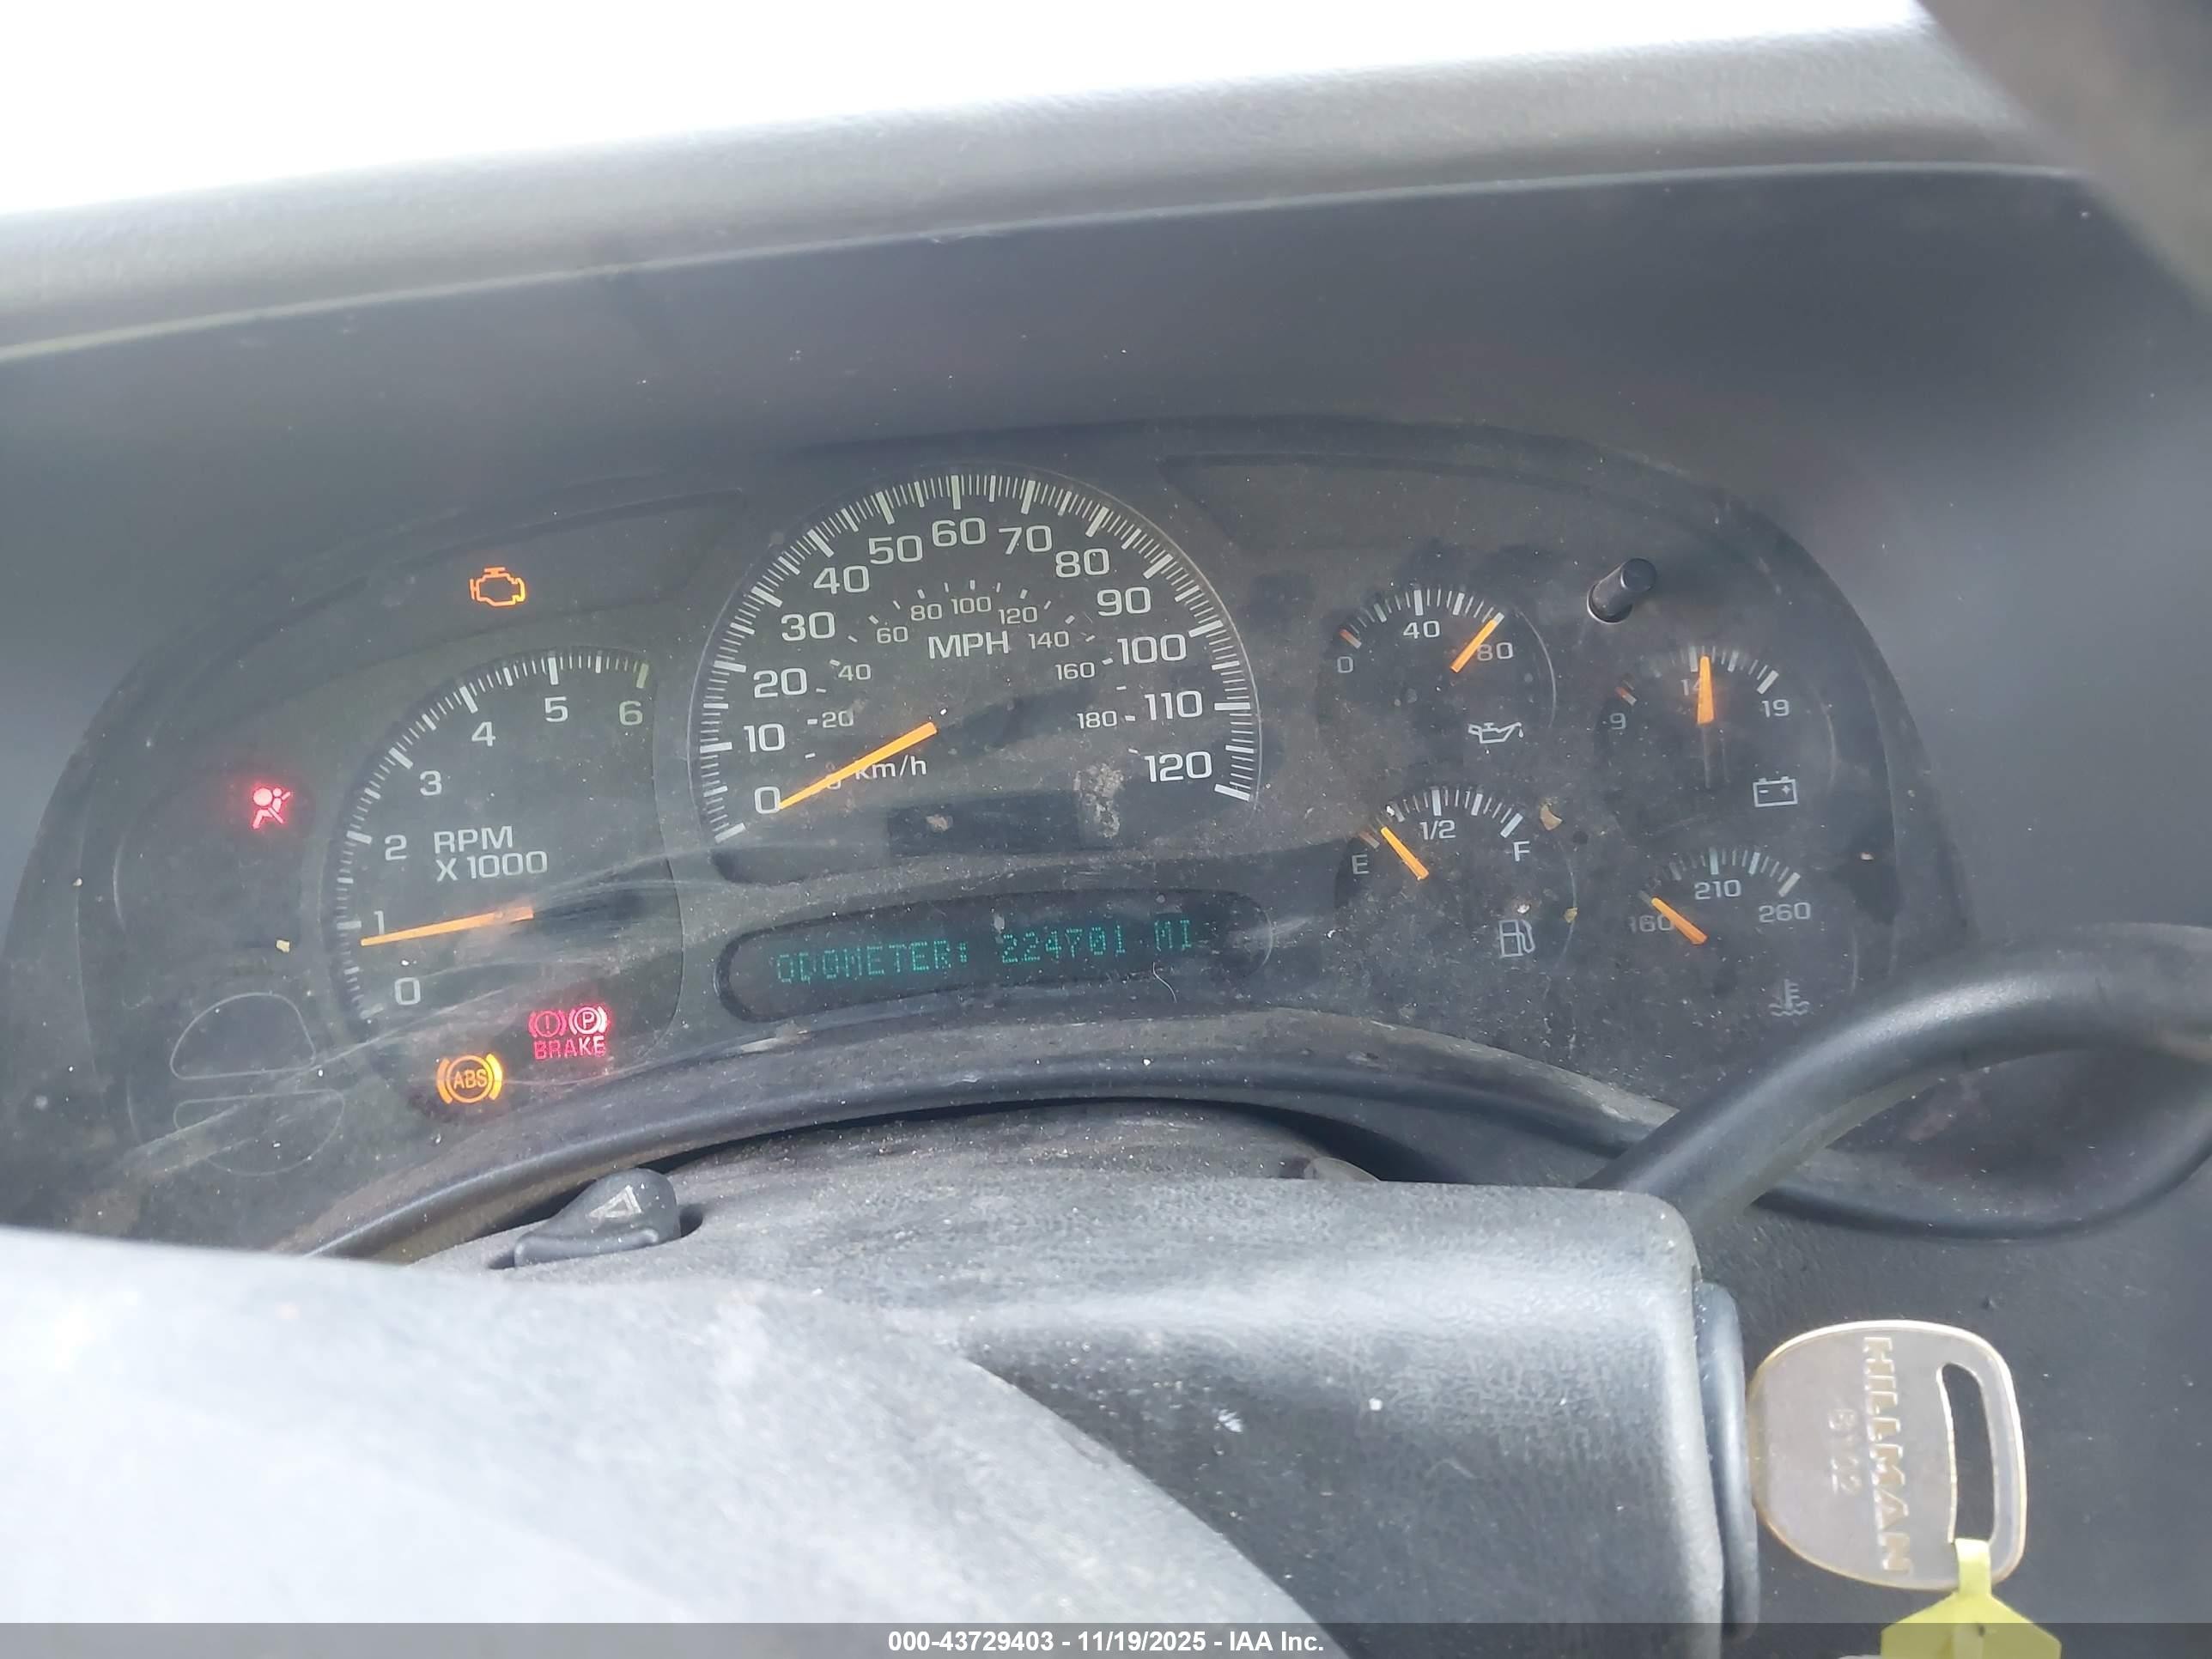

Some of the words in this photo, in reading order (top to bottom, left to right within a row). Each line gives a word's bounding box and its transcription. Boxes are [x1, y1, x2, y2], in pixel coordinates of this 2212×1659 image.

[932, 517, 986, 547] 60
[998, 525, 1053, 555] 70
[868, 535, 923, 565] 50
[1055, 548, 1110, 578] 80
[813, 565, 870, 594] 40
[910, 603, 942, 622] 80
[951, 596, 992, 615] 100
[1097, 586, 1152, 617] 90
[781, 611, 836, 641] 30
[999, 606, 1038, 624] 120
[877, 626, 908, 644] 60
[1029, 631, 1070, 649] 140
[1403, 620, 1441, 639] 40
[928, 630, 1010, 659] MPH
[1117, 634, 1187, 665] 100
[1477, 642, 1514, 661] 80
[838, 664, 872, 682] 40
[1054, 662, 1096, 680] 160
[1337, 656, 1353, 673] 0
[753, 668, 808, 698] 20
[545, 696, 568, 722] 5
[618, 701, 643, 726] 6
[1145, 690, 1203, 720] 110
[1762, 699, 1790, 718] 19
[822, 709, 854, 728] 20
[1077, 710, 1118, 729] 180
[1609, 713, 1626, 730] 9
[471, 721, 495, 746] 4
[744, 723, 786, 752] 10
[855, 755, 927, 781] km/h
[1145, 751, 1212, 782] 120
[420, 770, 442, 796] 3
[754, 786, 781, 814] 0
[433, 825, 514, 854] RPM
[1419, 820, 1456, 840] 1/2
[384, 835, 407, 860] 2
[1513, 841, 1530, 861] F
[436, 857, 458, 883] X
[466, 851, 548, 879] 1000
[1352, 854, 1370, 875] E
[1694, 879, 1741, 900] 210
[374, 910, 385, 936] 1
[1759, 902, 1811, 923] 260
[777, 940, 968, 985] ODOMETER:
[1002, 924, 1126, 963] 224701
[1154, 919, 1192, 950] MI
[394, 977, 421, 1006] 0
[533, 1035, 605, 1060] BRAKE
[453, 1068, 488, 1089] ABS
[1863, 1336, 1913, 1576] HILLMAN
